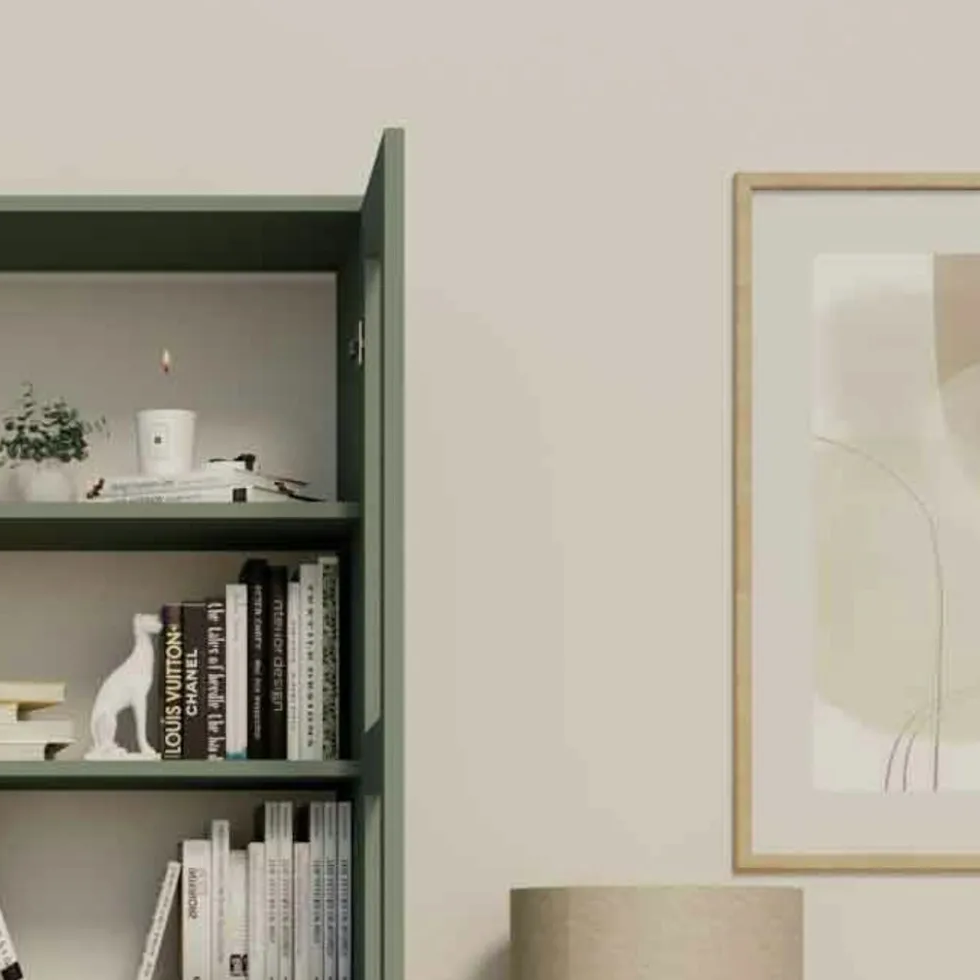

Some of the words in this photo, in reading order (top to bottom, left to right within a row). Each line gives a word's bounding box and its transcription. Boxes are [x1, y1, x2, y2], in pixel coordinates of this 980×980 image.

[165, 632, 182, 702] VUITTON
[186, 649, 198, 716] CHANEL
[165, 705, 182, 755] LOUIS
